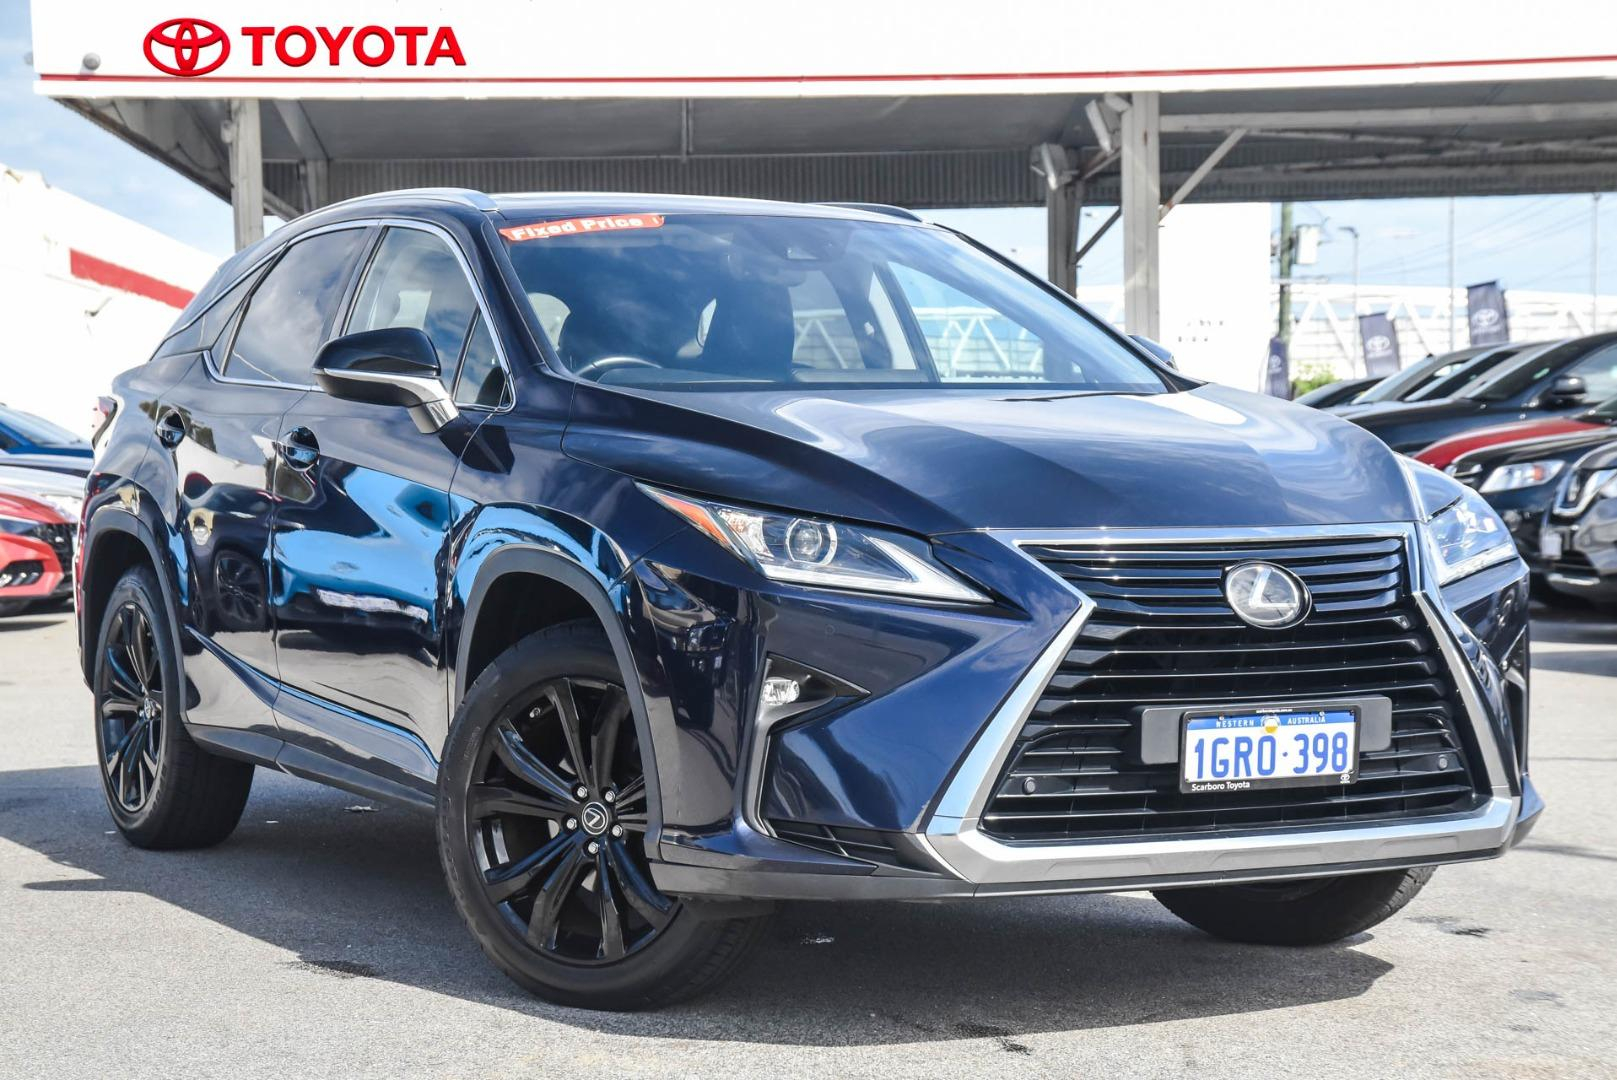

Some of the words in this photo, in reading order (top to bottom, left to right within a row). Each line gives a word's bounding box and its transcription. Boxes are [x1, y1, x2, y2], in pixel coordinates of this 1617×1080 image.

[241, 26, 467, 67] TOYOTA
[511, 221, 576, 241] Fixed
[580, 216, 643, 231] Price
[1216, 719, 1254, 728] WESTERN
[1287, 716, 1326, 725] AUSTRALIA
[1191, 782, 1225, 792] Scarboro
[1226, 780, 1250, 791] Toyota
